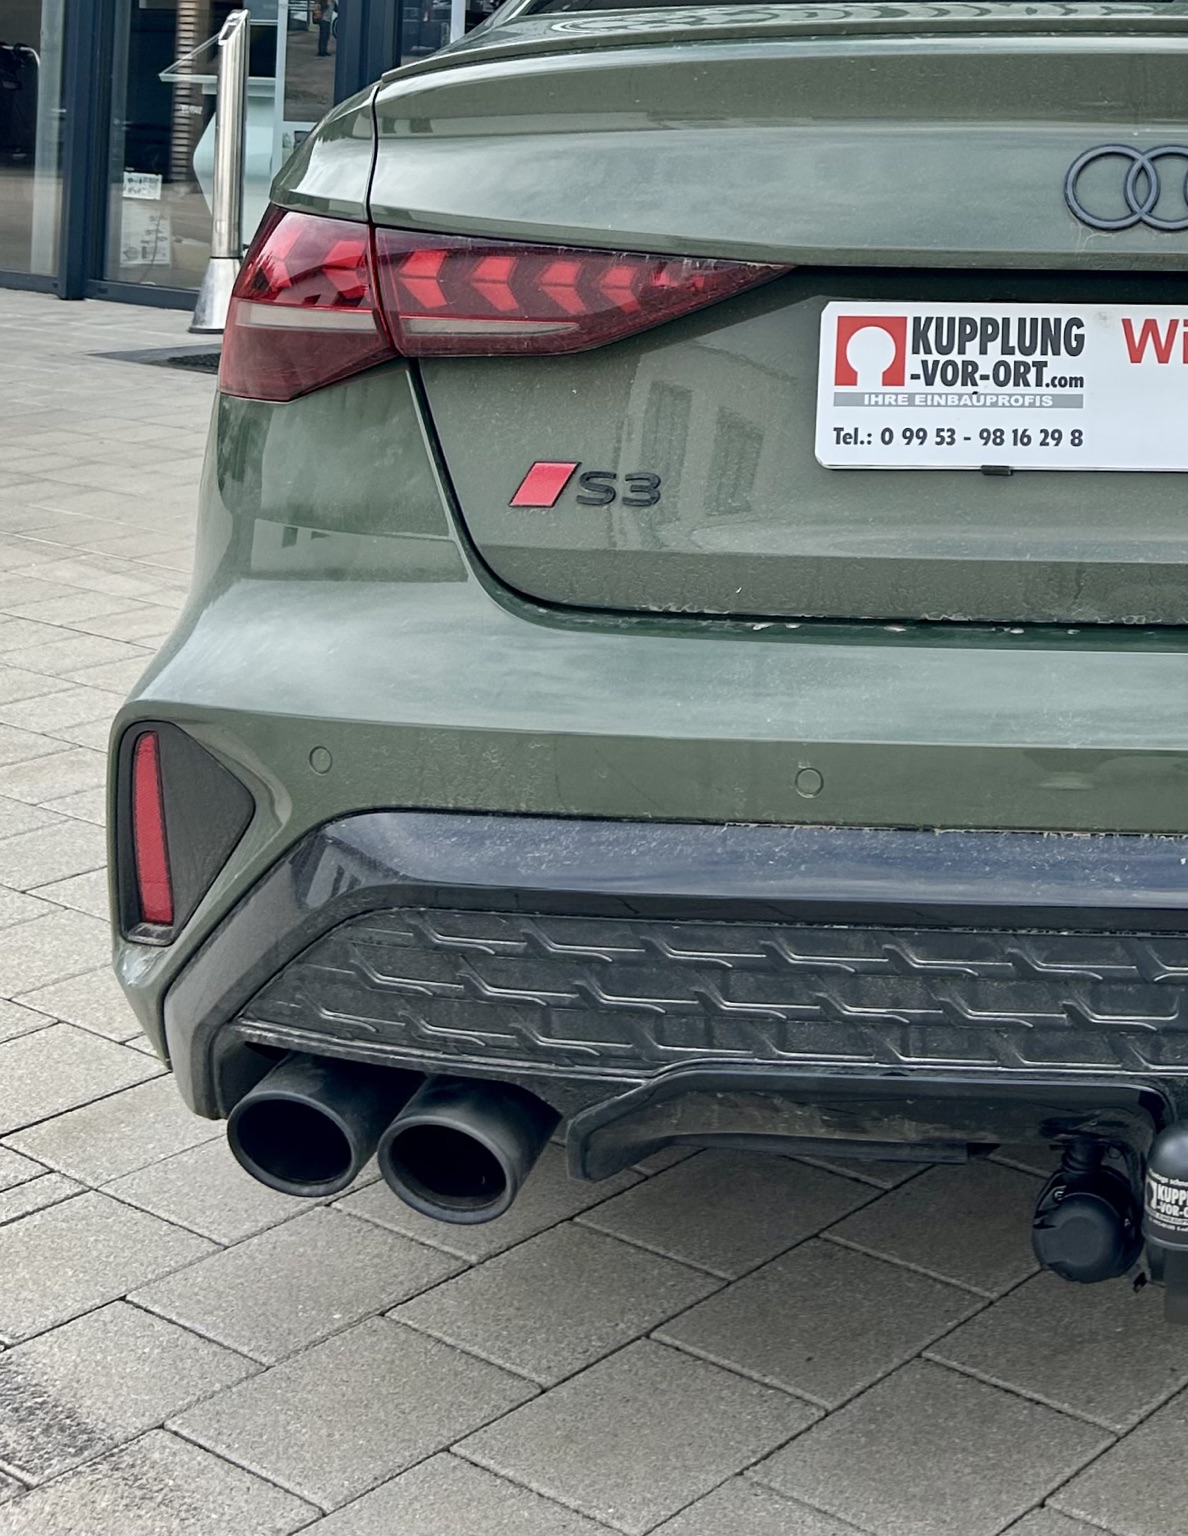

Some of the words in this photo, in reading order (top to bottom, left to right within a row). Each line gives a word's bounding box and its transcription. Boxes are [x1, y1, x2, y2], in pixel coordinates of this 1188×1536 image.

[911, 316, 1086, 357] KUPPLUNG
[910, 359, 1085, 389] -VOR-ORT.com
[863, 394, 909, 406] IHRE
[914, 394, 1054, 407] EINBAUPROFIS
[833, 427, 873, 446] Tel.:
[880, 427, 894, 446] 0
[901, 427, 928, 446] 99
[934, 427, 957, 446] 53
[978, 428, 1005, 447] 98
[1012, 428, 1032, 447] 16
[1039, 428, 1063, 447] 29
[1070, 429, 1084, 447] 8
[576, 470, 662, 507] S3
